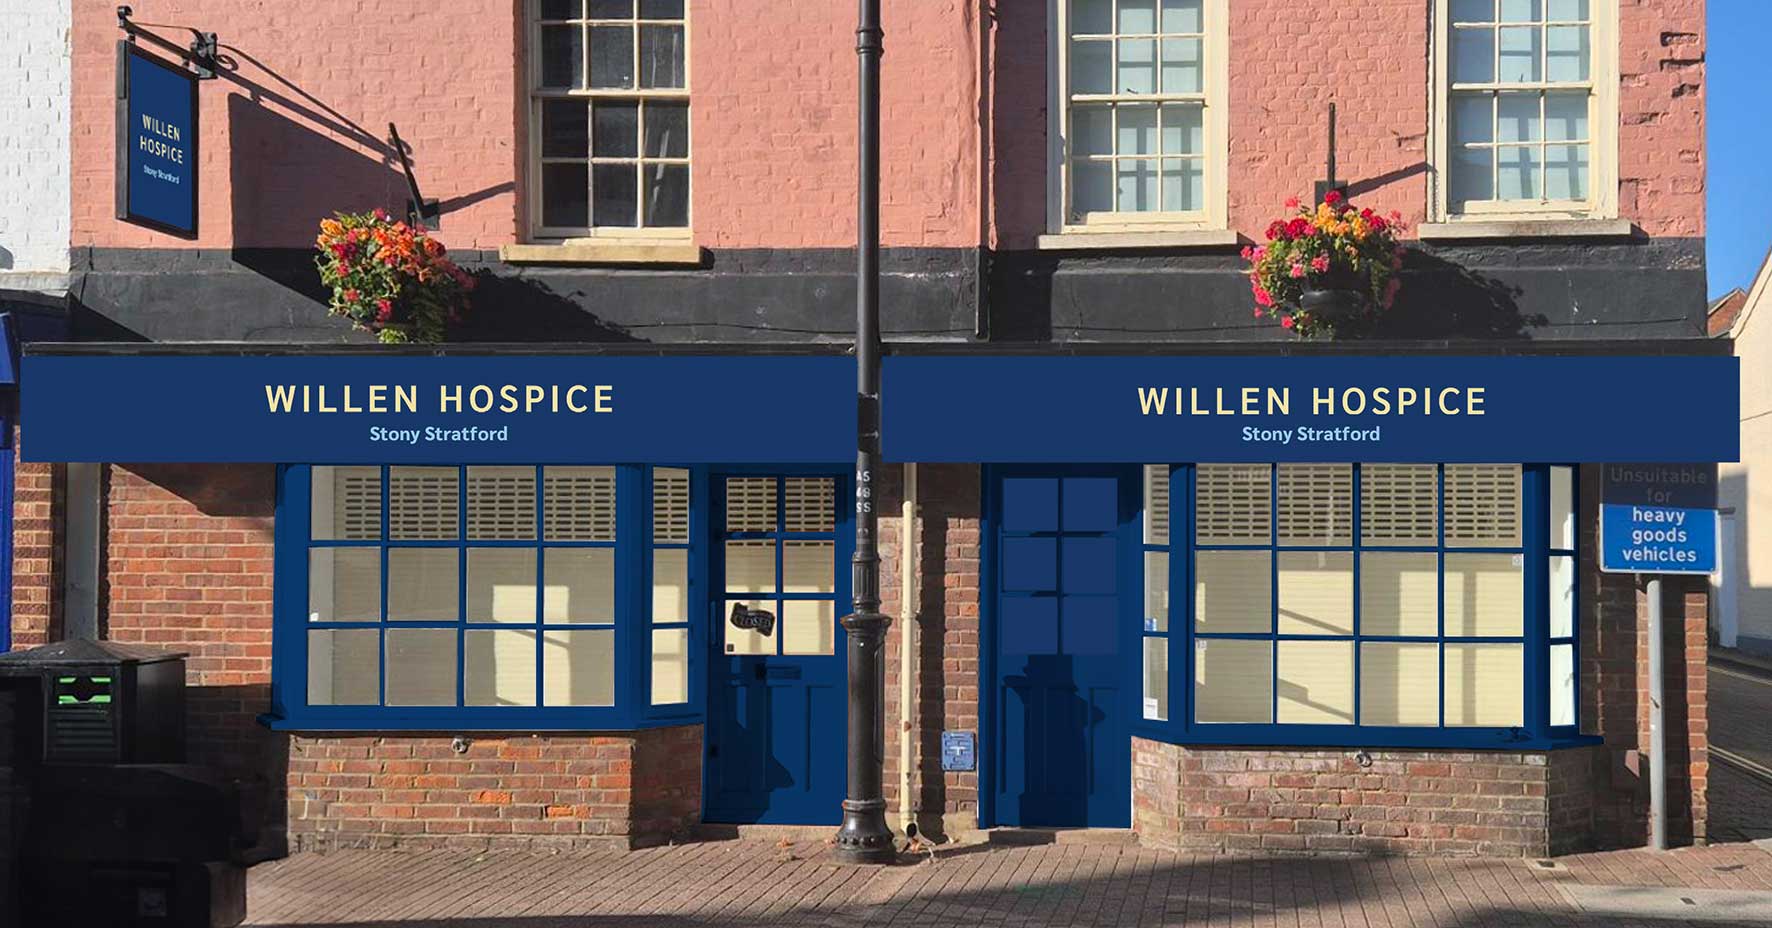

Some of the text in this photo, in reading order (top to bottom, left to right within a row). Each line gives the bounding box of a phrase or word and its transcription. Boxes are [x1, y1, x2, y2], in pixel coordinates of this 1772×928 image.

[142, 114, 180, 142] WILLEN
[139, 135, 183, 164] HOSPICE
[265, 384, 613, 413] WILLEN HOSPICE
[1138, 386, 1486, 415] WILLEN HOSPICE
[369, 425, 508, 444] Stony Stratford
[1241, 425, 1381, 444] Stony Stratford
[1610, 467, 1707, 484] Unsuitable
[1646, 487, 1672, 503] for
[1633, 507, 1685, 525] heavy
[1632, 528, 1687, 544] goods
[1622, 546, 1697, 562] vehicles
